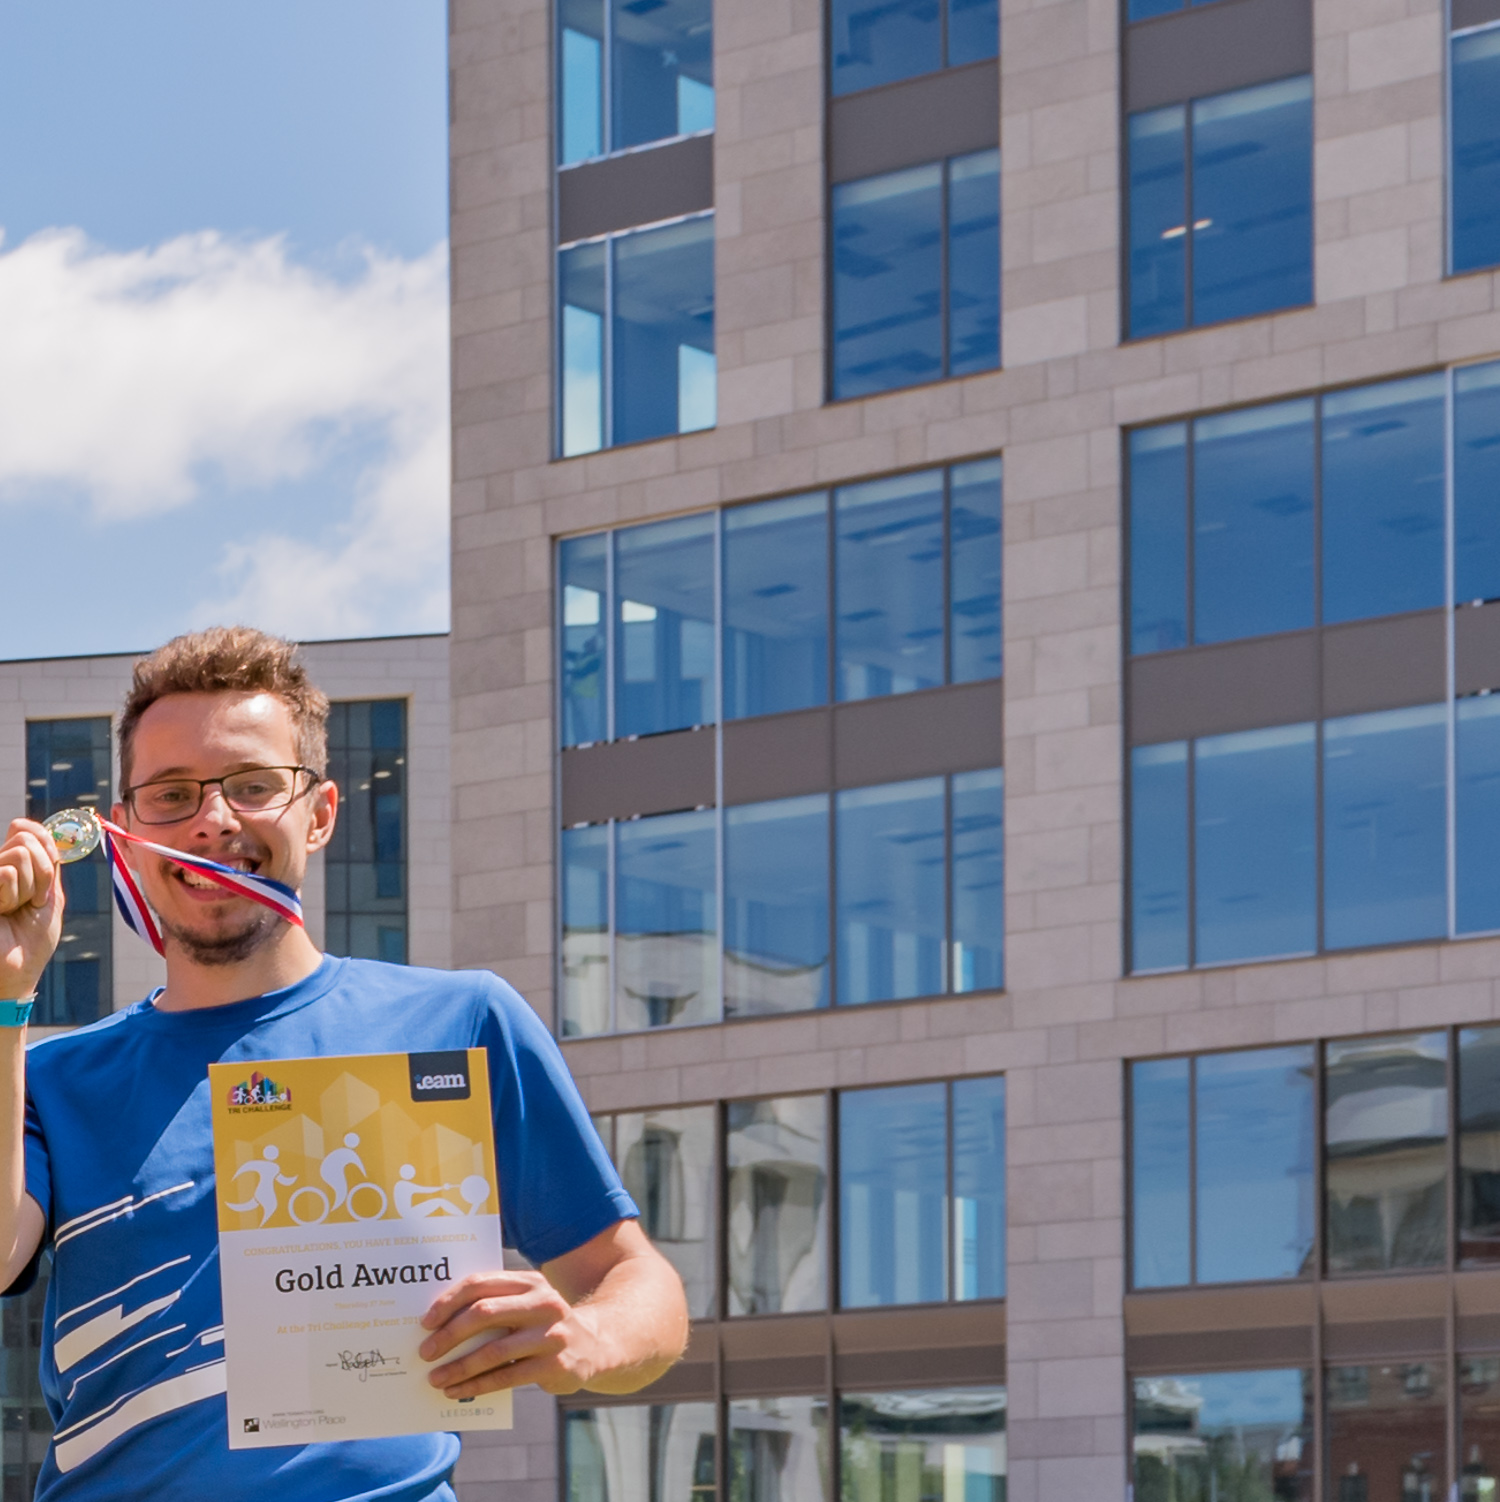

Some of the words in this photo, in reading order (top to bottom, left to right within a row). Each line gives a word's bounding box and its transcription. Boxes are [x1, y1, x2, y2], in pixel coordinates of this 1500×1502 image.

[228, 1106, 241, 1114] TRI
[242, 1103, 292, 1113] CHALLENGE
[343, 1239, 364, 1249] YOU
[365, 1237, 392, 1248] HAVE
[393, 1235, 419, 1246] BEEN
[421, 1233, 468, 1244] AWARDED
[275, 1264, 345, 1293] Gold
[351, 1257, 452, 1288] Award
[276, 1325, 289, 1334] At
[290, 1323, 306, 1333] the
[307, 1321, 322, 1332] Tri
[323, 1319, 371, 1332] Challenge
[373, 1317, 401, 1328] Event
[440, 1407, 495, 1419] LEEDSBID
[262, 1416, 316, 1431] Wellington
[318, 1414, 346, 1425] Place
